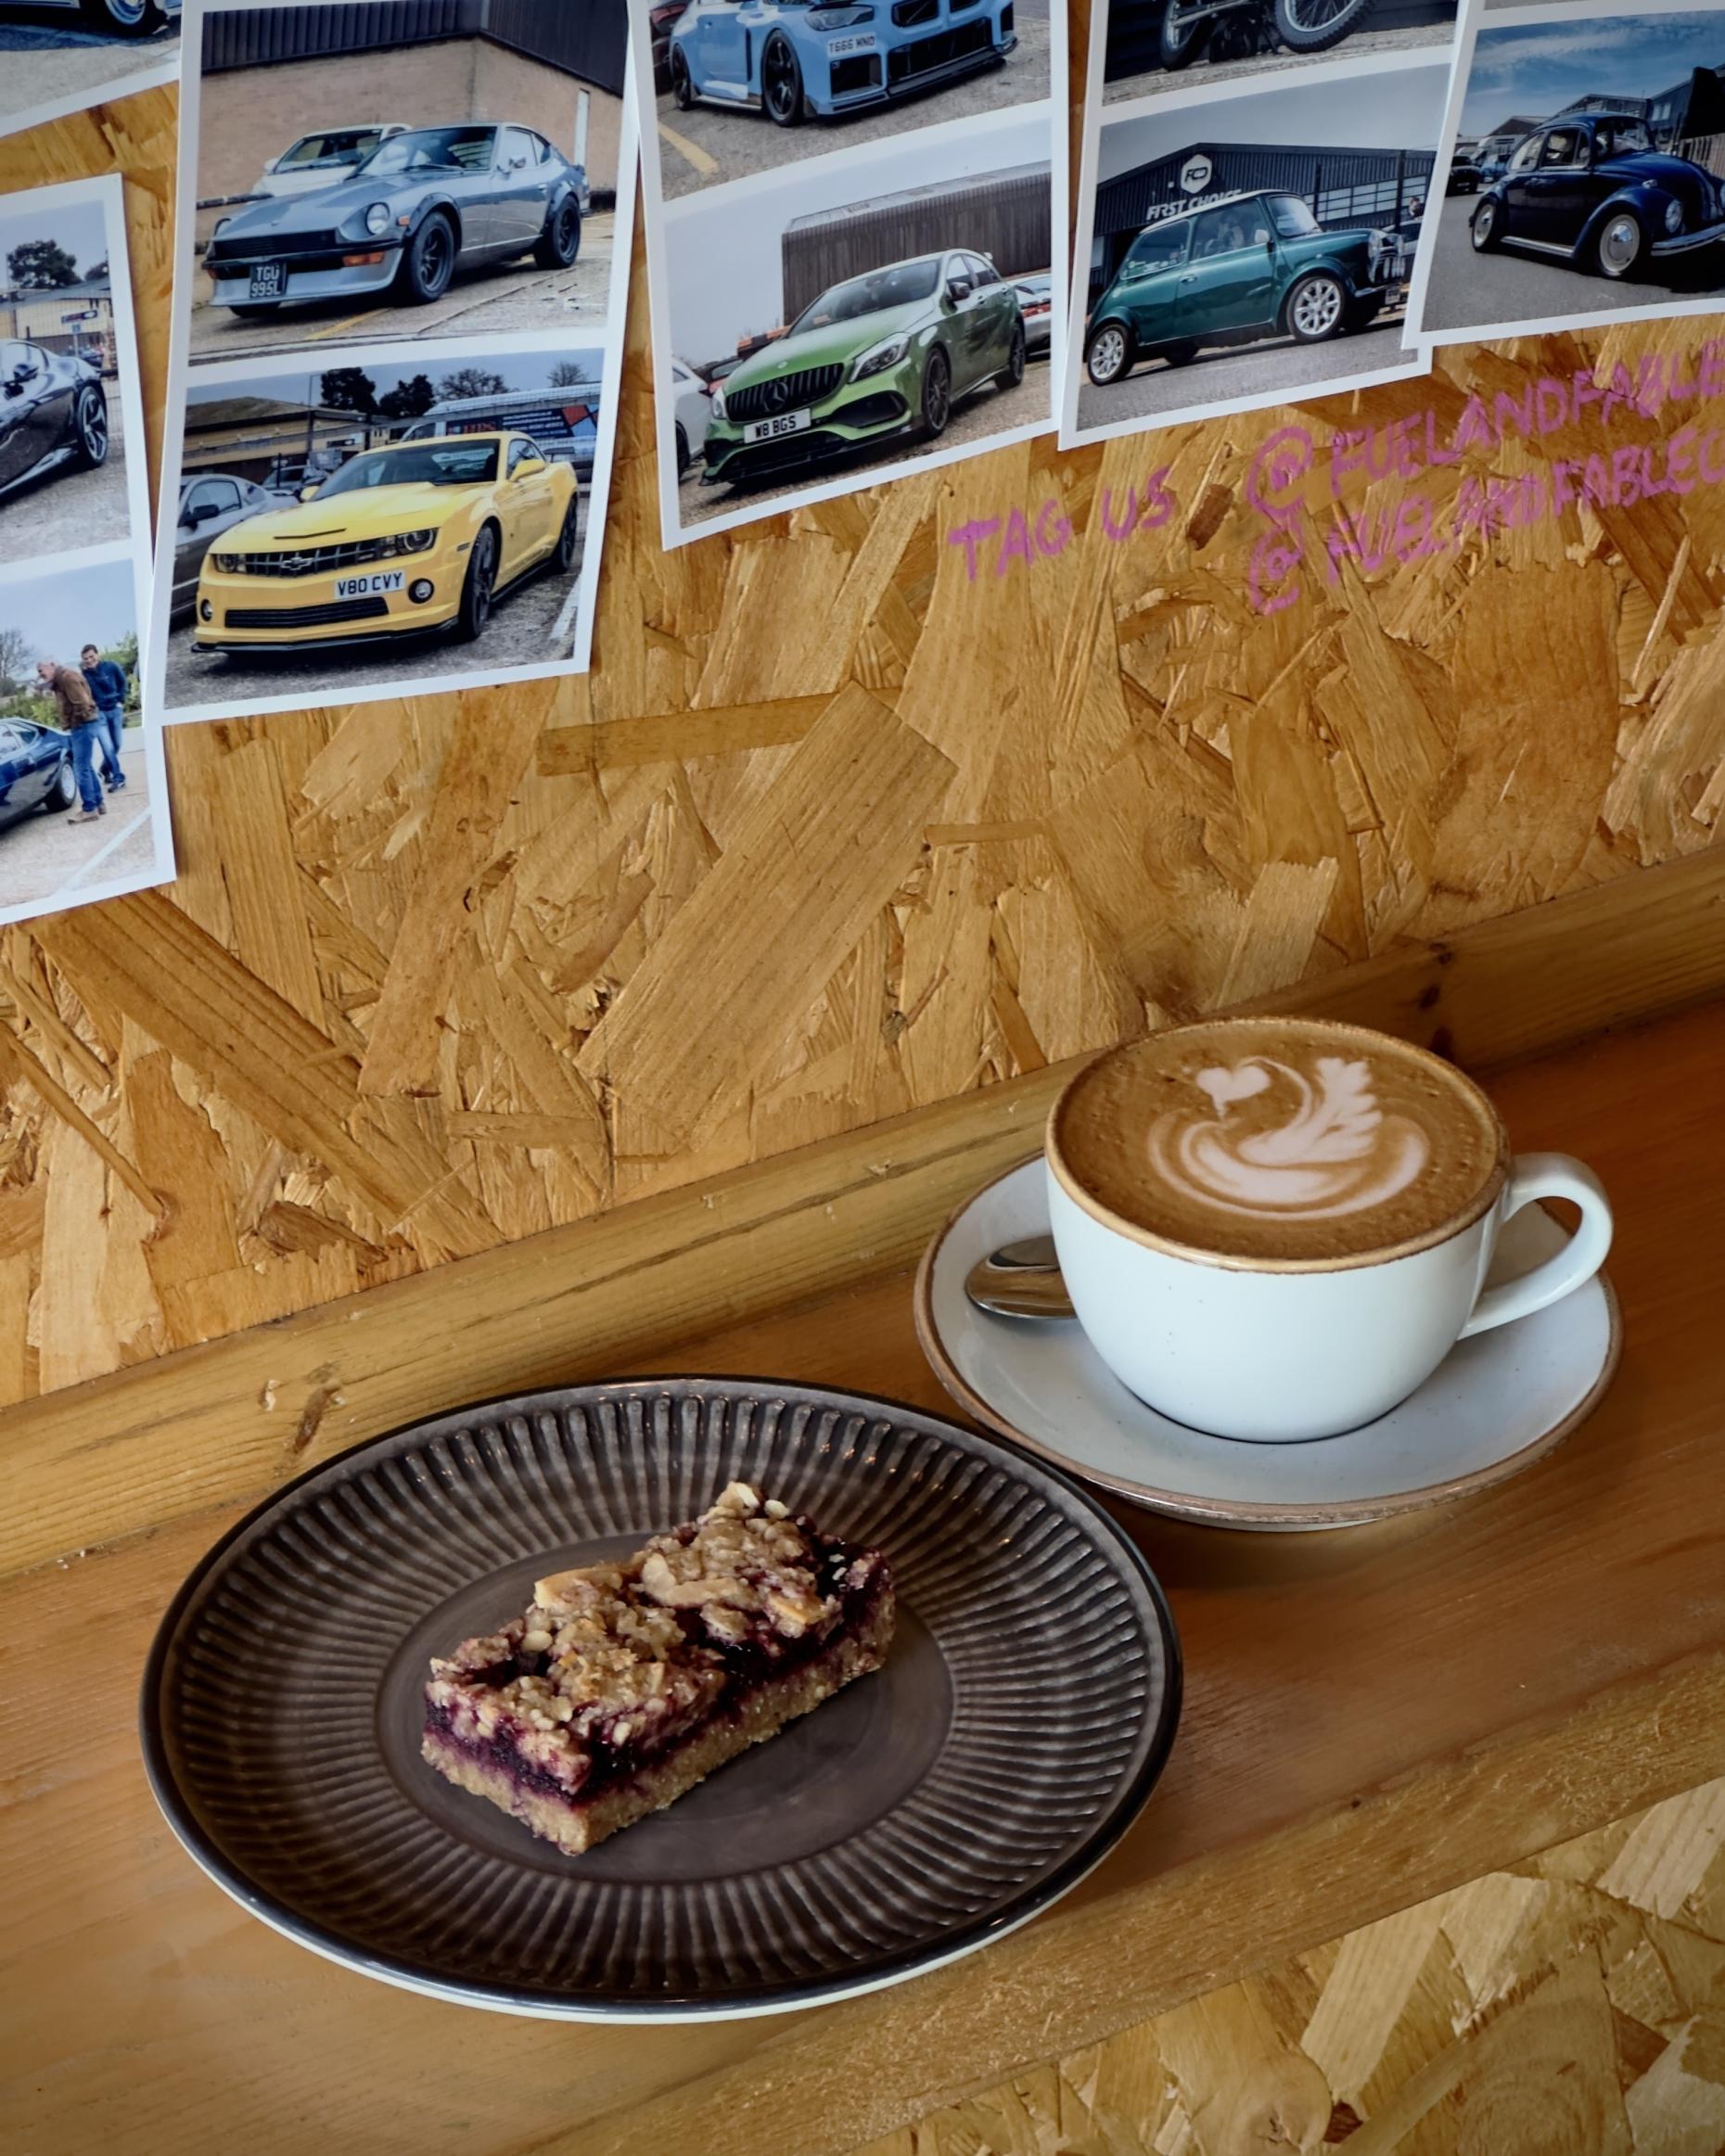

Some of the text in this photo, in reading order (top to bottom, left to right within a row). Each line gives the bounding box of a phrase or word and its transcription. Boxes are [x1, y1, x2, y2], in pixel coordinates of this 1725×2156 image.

[1146, 199, 1187, 221] FIRST
[251, 280, 282, 298] 995L
[948, 466, 1173, 585] TAG US
[338, 571, 402, 596] V80 CVY
